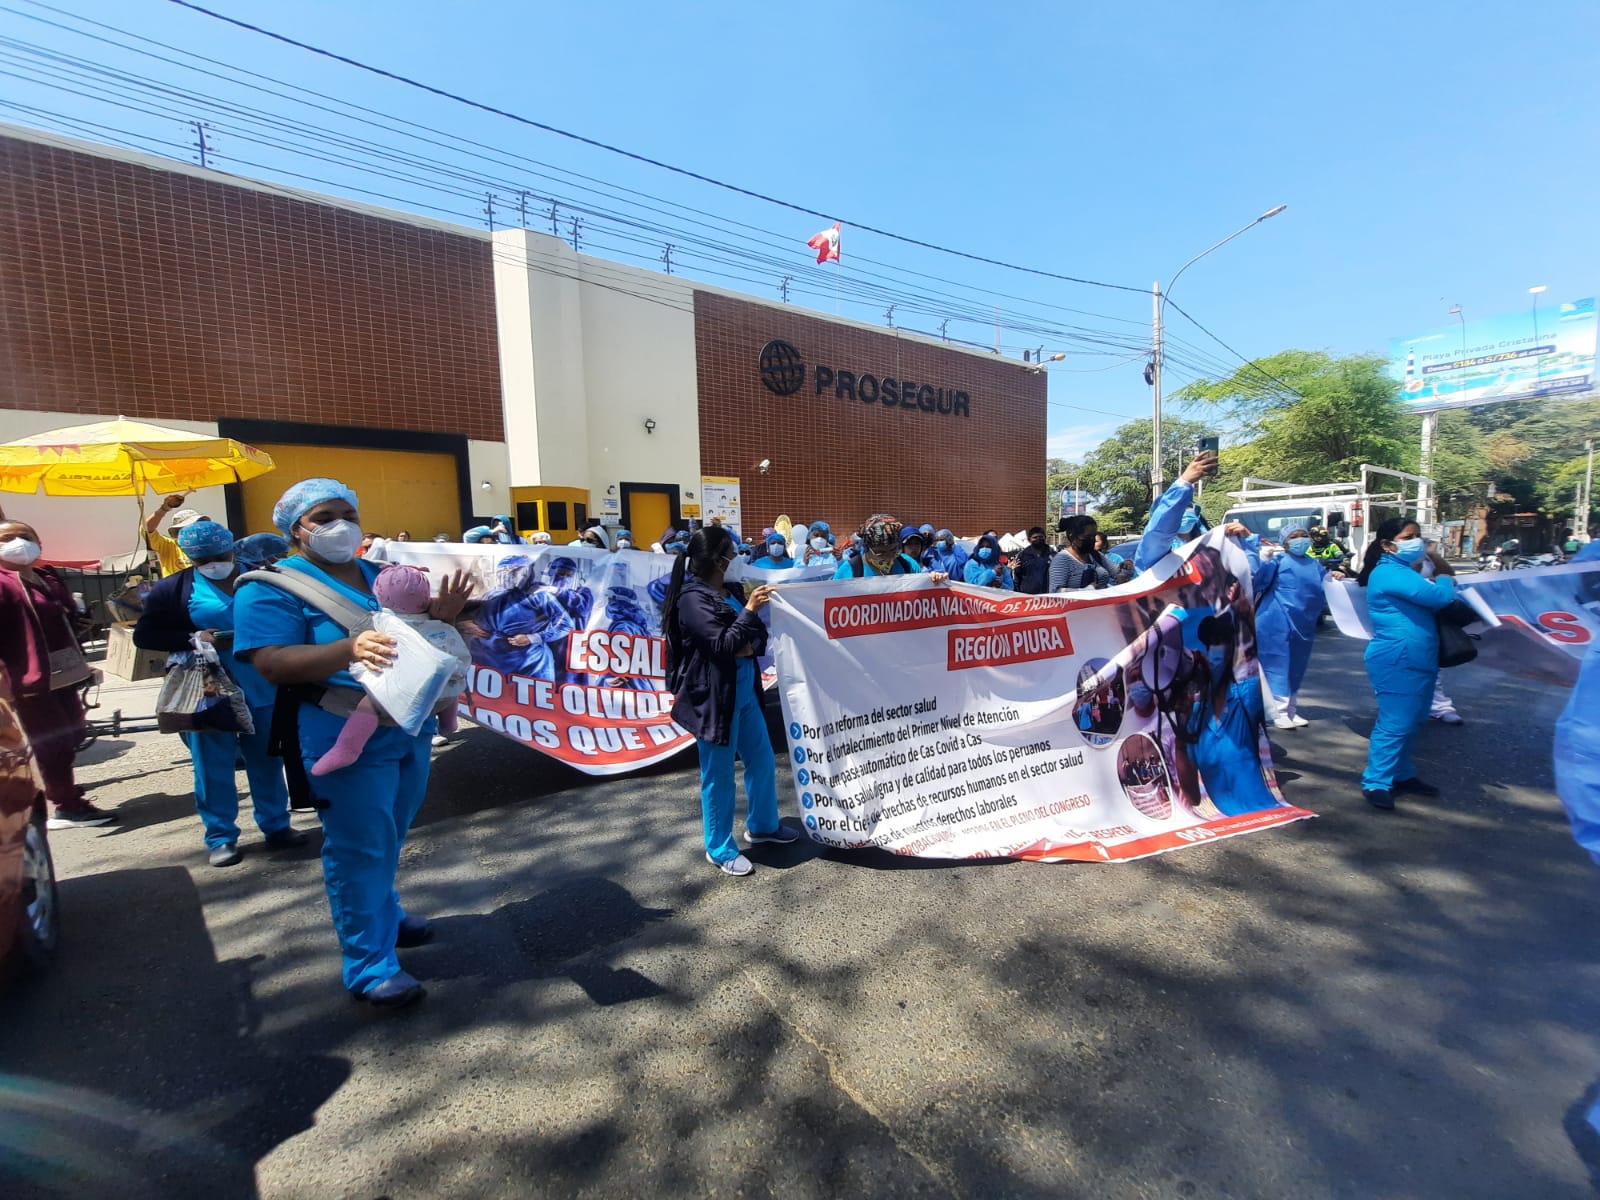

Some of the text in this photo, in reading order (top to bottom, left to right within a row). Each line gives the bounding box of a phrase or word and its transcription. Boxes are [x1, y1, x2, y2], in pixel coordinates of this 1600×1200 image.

[815, 365, 970, 417] PROSEGUR
[829, 597, 938, 629] COORDINADORA
[1000, 601, 1022, 614] DE
[570, 632, 666, 677] ESSAL
[1012, 626, 1065, 655] PIURA
[512, 675, 555, 710] TE
[562, 685, 675, 720] OLVIDE
[803, 696, 937, 740] Por una reforma del sector salud
[568, 725, 646, 755] QUE
[806, 706, 1020, 764] Por el fortalecimiento del Primer Nivel de Atención
[811, 770, 826, 785] Por
[859, 752, 906, 777] automático
[908, 747, 919, 762] de
[920, 744, 935, 759] Cas
[936, 736, 959, 755] Covid
[960, 739, 967, 750] a
[966, 733, 982, 747] Cas
[815, 793, 833, 808] Por
[894, 777, 902, 795] y
[902, 773, 914, 788] de
[915, 762, 947, 786] calidad
[948, 761, 967, 779] para
[967, 753, 993, 771] todos
[993, 750, 1008, 764] los
[1009, 739, 1051, 766] peruanos
[818, 816, 836, 831] Por
[840, 818, 850, 832] el
[917, 793, 928, 807] de
[929, 784, 967, 804] recursos
[966, 773, 1007, 794] humanos
[1008, 770, 1020, 783] en
[1021, 764, 1030, 780] el
[1031, 759, 1057, 778] sector
[1060, 750, 1084, 770] salud
[1011, 808, 1036, 827] PLENO
[1034, 805, 1049, 820] DEL
[1049, 794, 1091, 816] CONGRESO
[891, 827, 903, 841] de
[936, 806, 977, 828] derechos
[976, 794, 1018, 817] laborales
